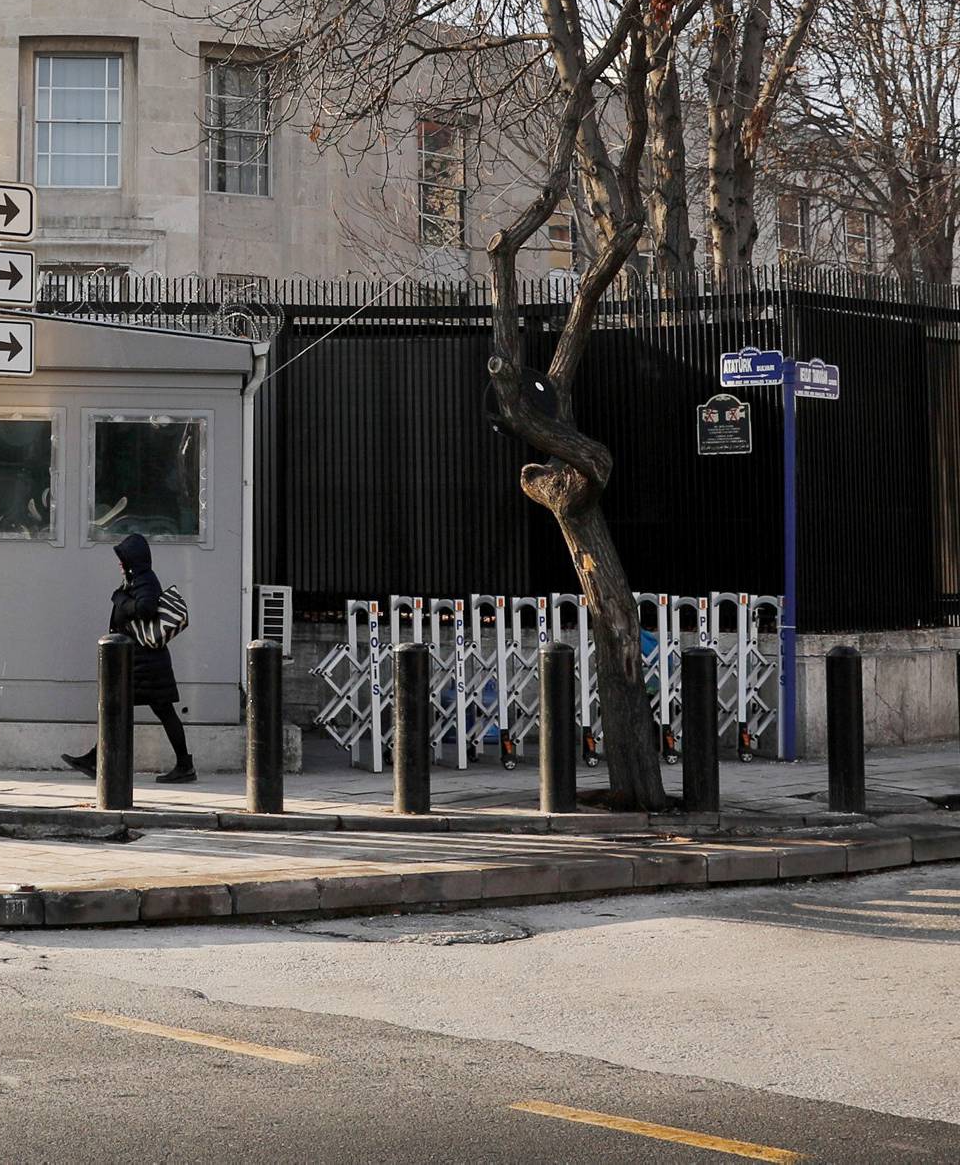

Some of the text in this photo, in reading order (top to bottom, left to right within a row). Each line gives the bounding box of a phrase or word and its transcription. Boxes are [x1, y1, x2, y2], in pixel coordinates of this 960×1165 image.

[723, 356, 753, 375] ATATÜRK
[370, 621, 380, 695] POLİS
[456, 619, 465, 693] POLİS
